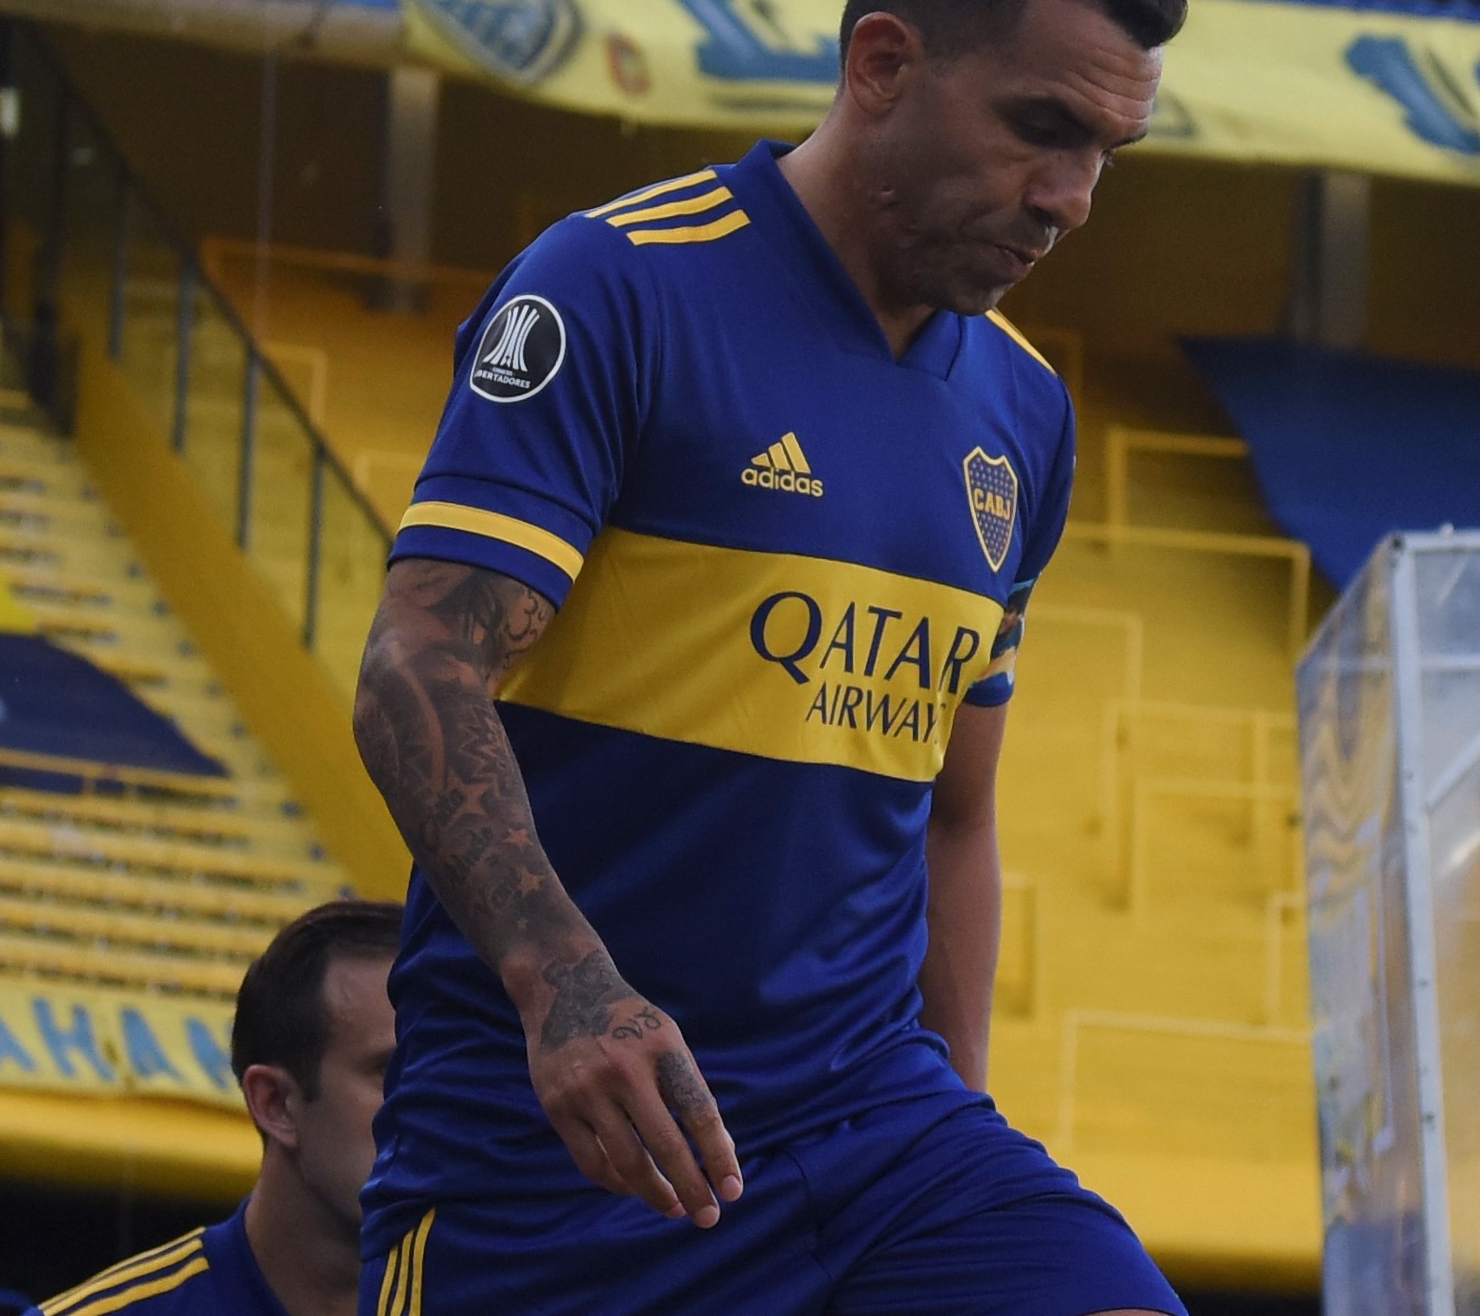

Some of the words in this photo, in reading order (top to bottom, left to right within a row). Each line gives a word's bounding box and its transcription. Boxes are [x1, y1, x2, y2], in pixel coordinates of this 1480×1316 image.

[740, 466, 824, 498] adidas
[973, 488, 1012, 521] CABJ
[749, 591, 981, 696] QATAR
[805, 681, 947, 744] AIRWAY
